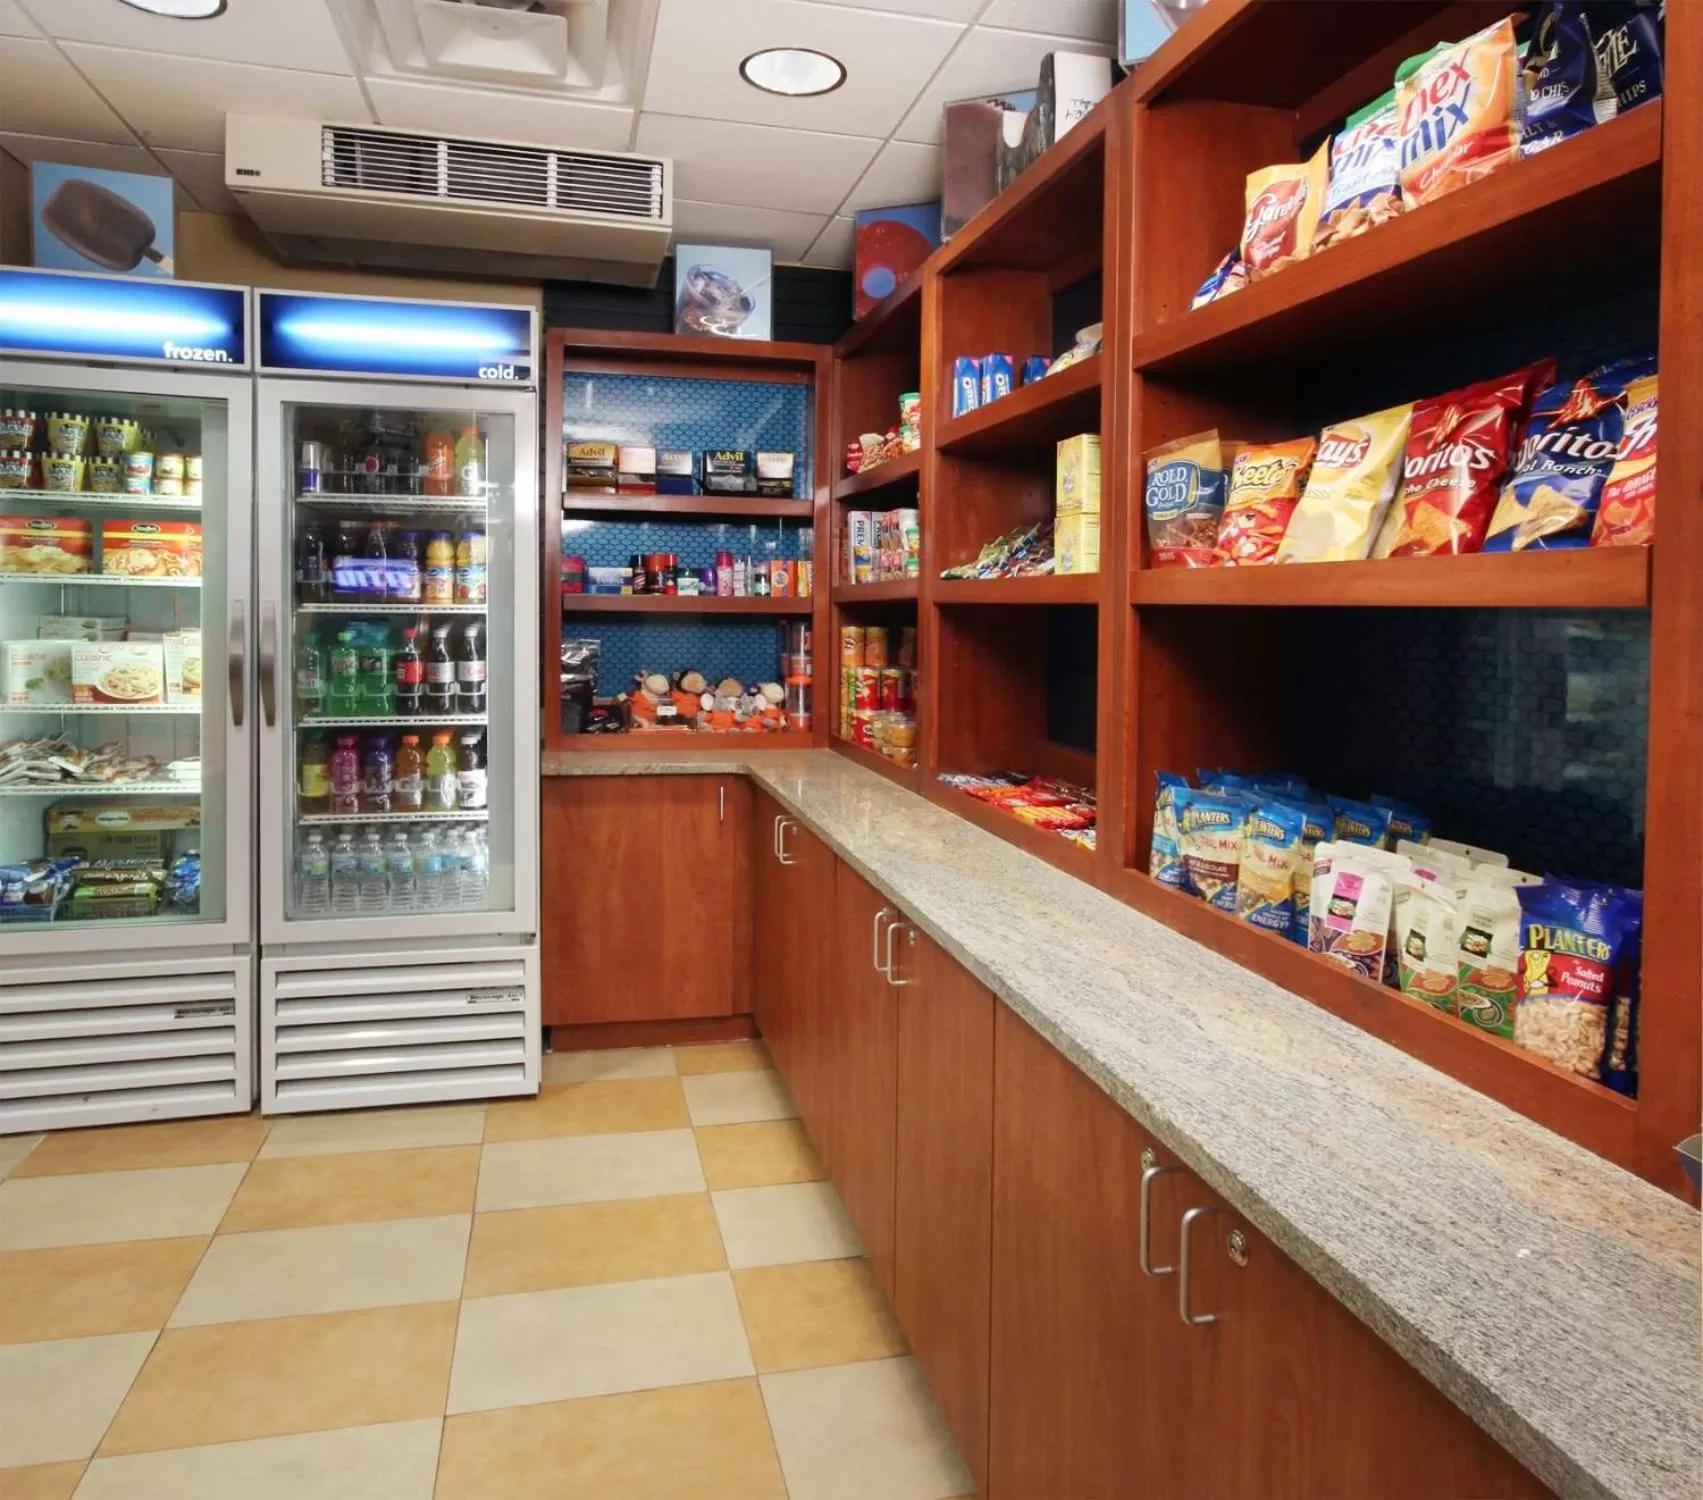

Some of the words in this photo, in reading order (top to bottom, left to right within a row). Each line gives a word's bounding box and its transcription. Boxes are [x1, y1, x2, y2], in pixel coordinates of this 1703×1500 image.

[1400, 47, 1471, 136] hex
[1617, 79, 1647, 107] HIPS
[1401, 82, 1469, 169] mix
[1521, 121, 1544, 138] ALT
[163, 340, 233, 363] frozen.
[478, 364, 519, 381] cold.
[579, 447, 606, 456] Advil
[714, 450, 745, 461] Advil
[1317, 439, 1369, 466] ay's
[1404, 440, 1496, 479] oritos
[1516, 426, 1614, 472] orito
[1152, 466, 1187, 486] ROLD
[1541, 461, 1596, 475] Ranch
[1146, 483, 1186, 507] GOLD
[1218, 839, 1239, 851] MIX
[1268, 853, 1288, 868] MIX
[1561, 970, 1602, 994] Peanuts
[1576, 965, 1604, 982] Salted
